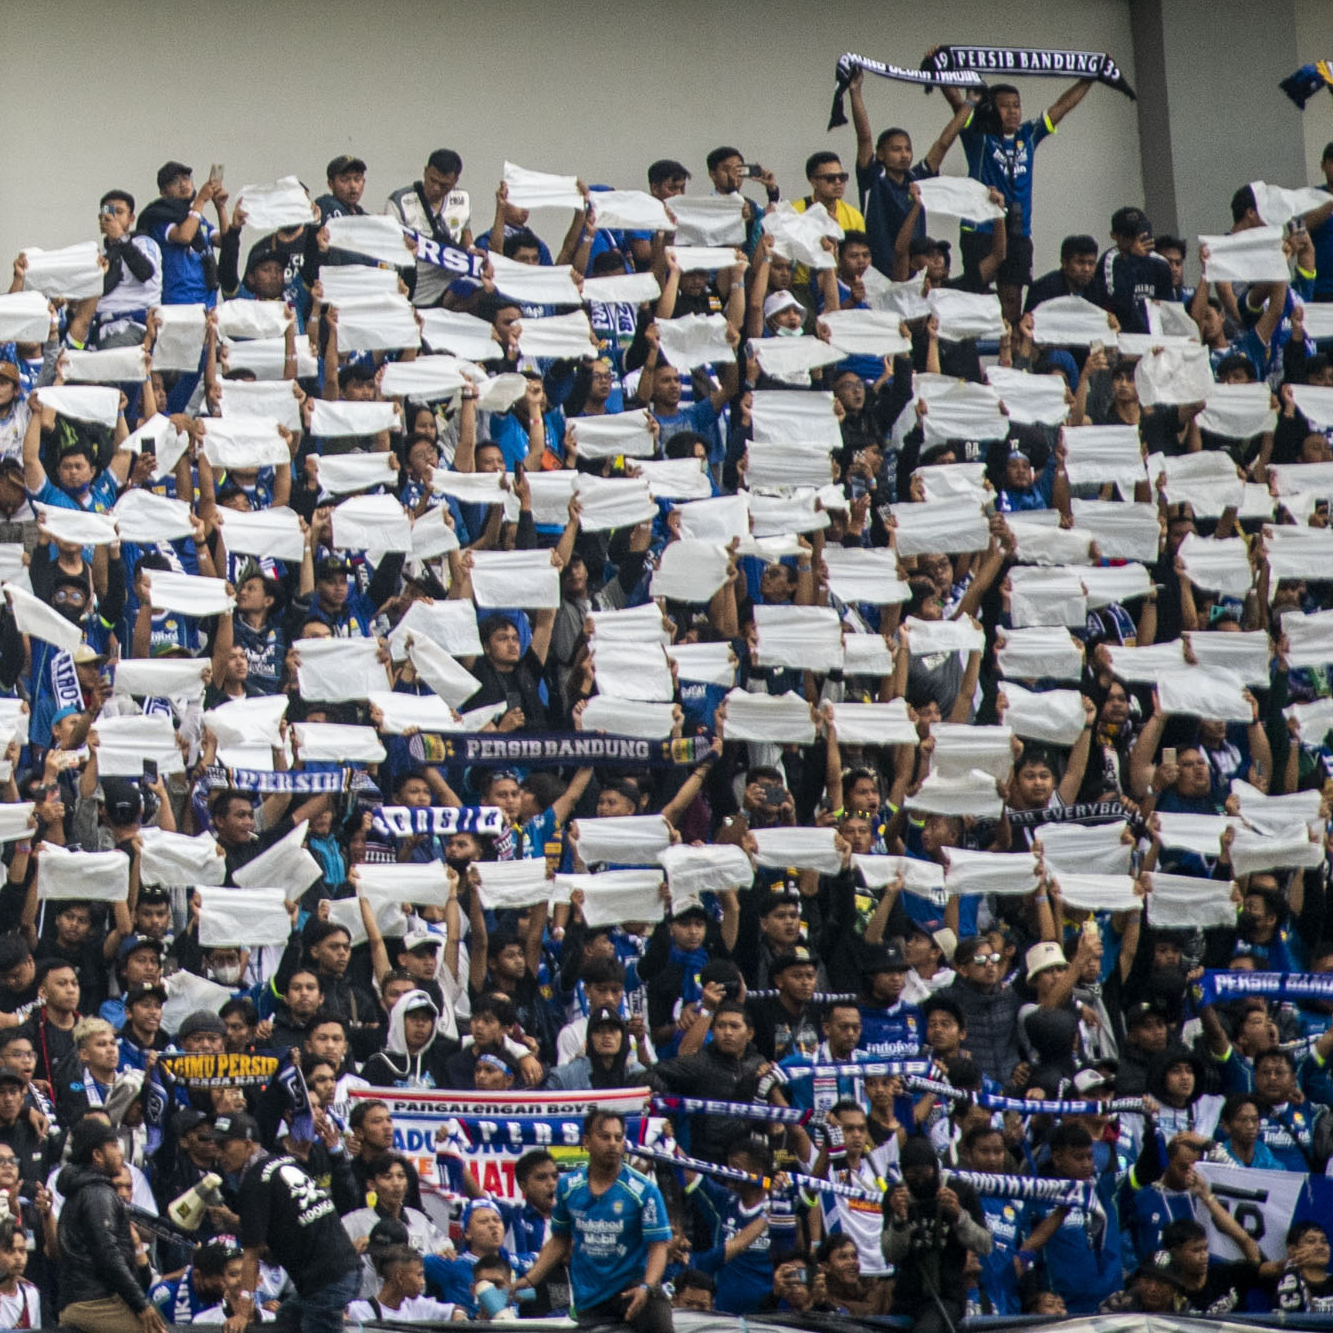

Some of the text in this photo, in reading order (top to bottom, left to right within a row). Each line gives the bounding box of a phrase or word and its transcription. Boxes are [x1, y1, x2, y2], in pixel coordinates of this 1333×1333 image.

[956, 50, 1015, 69] PERSIB
[1019, 52, 1099, 73] BANDUNG
[466, 739, 650, 760] PERSIB BANDUNG
[240, 770, 341, 793] PERSIB
[217, 1053, 279, 1079] PERSIB
[547, 1101, 600, 1115] BOYS
[1022, 1175, 1086, 1205] KOREA
[574, 1217, 625, 1232] Indofood
[583, 1232, 618, 1245] Mobil
